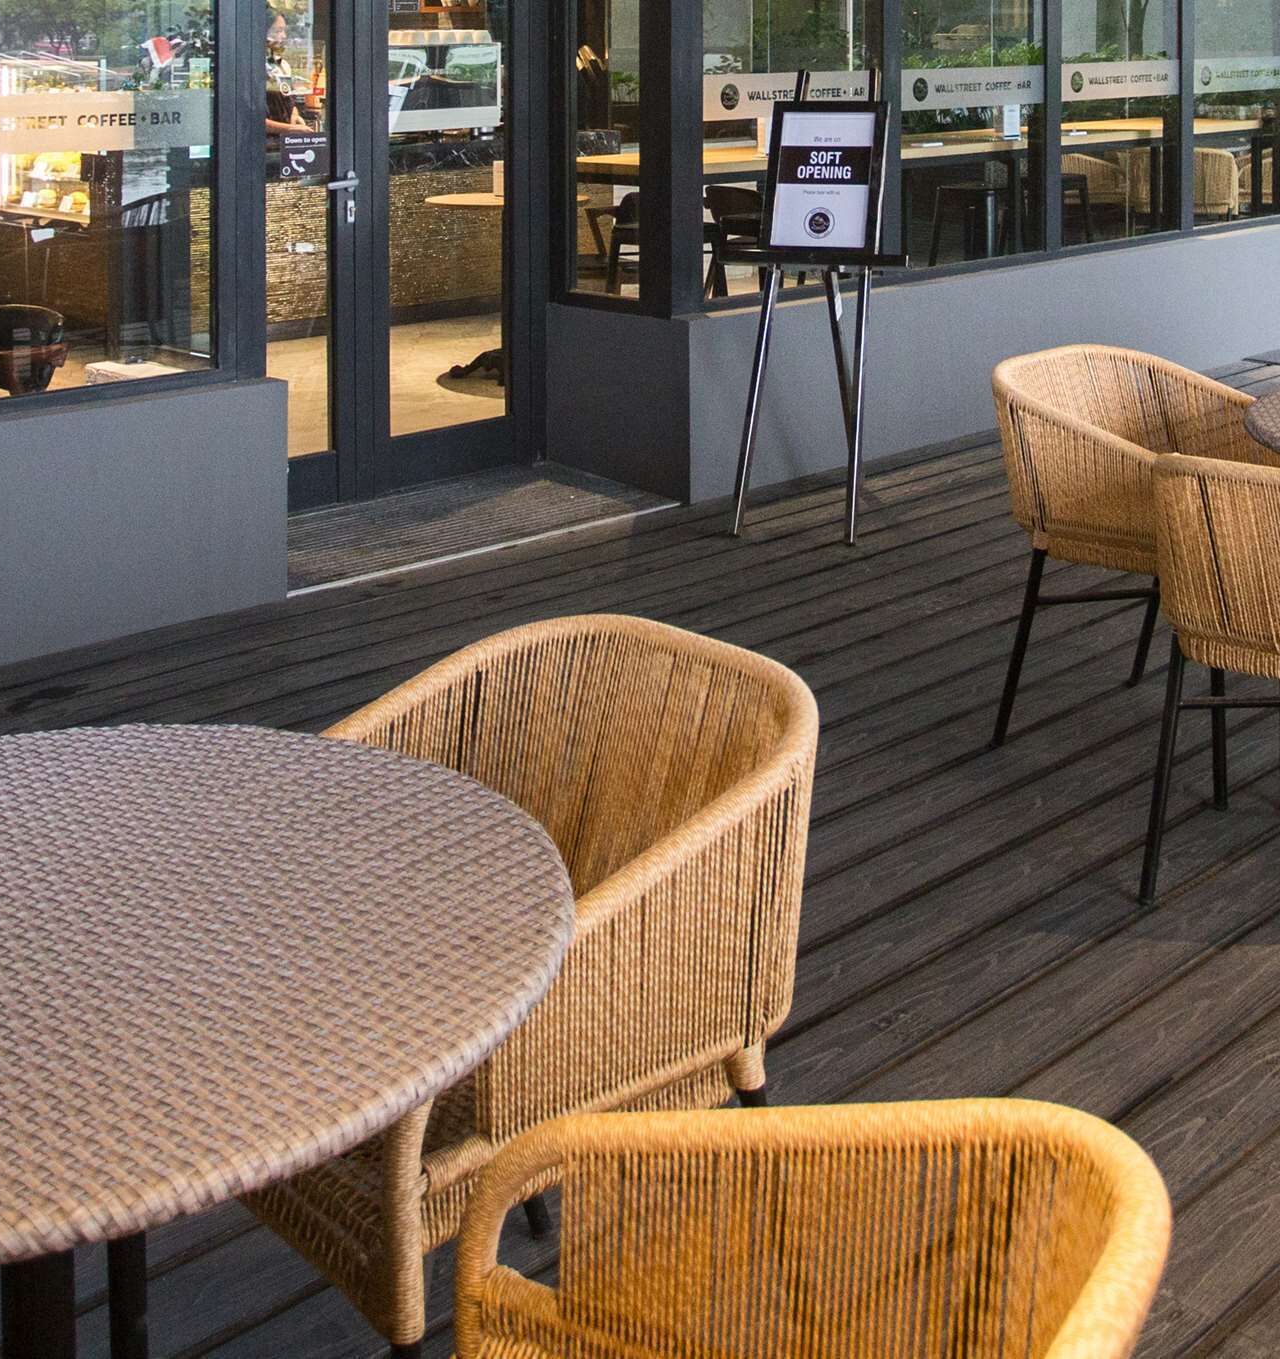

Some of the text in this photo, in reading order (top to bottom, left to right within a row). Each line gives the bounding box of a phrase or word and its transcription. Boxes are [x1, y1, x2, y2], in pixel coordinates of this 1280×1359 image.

[746, 89, 796, 101] WALLSTRE
[809, 87, 842, 98] COFFEE
[76, 113, 137, 129] COFFEE
[150, 111, 182, 126] BAR
[810, 151, 843, 165] SOFT
[797, 166, 852, 179] OPENING
